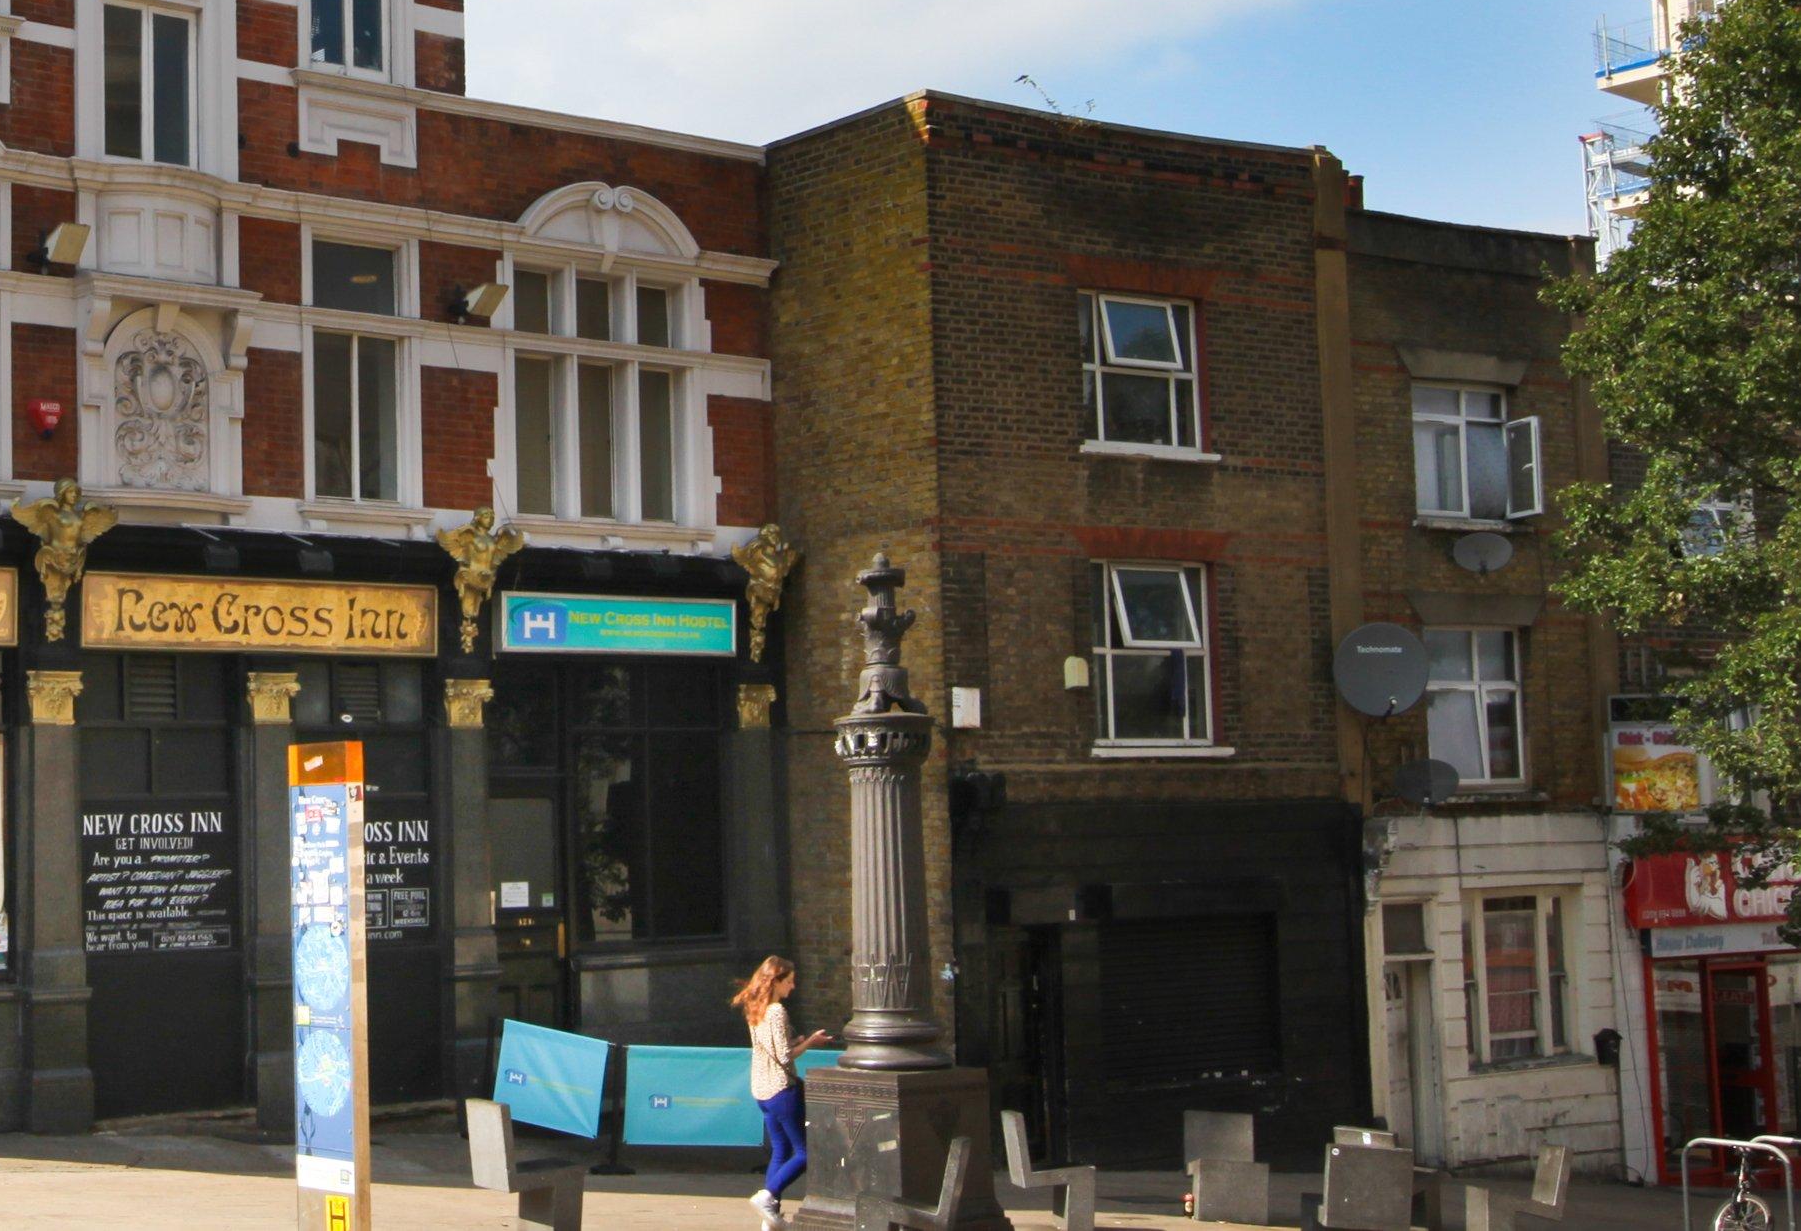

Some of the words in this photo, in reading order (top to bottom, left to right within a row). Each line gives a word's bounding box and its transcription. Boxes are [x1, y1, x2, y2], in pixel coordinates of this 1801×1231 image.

[114, 587, 203, 634] New
[212, 592, 333, 638] Cross
[345, 596, 408, 641] Inn
[605, 611, 649, 626] CROSS
[679, 614, 728, 629] HOSTEL
[83, 814, 123, 835] NEW
[130, 812, 184, 835] CROSS
[190, 812, 223, 833] INN
[364, 821, 393, 843] OSS
[398, 820, 429, 842] INN
[115, 837, 135, 851] GET
[139, 836, 193, 850] INVOLVED!
[93, 852, 110, 866] Are
[113, 856, 134, 868] you
[379, 852, 386, 865] &
[389, 846, 429, 865] Events
[375, 867, 404, 884] week
[99, 886, 124, 896] WANT
[125, 886, 137, 895] TO
[169, 884, 179, 893] A
[169, 894, 209, 905] EVENT?
[86, 910, 106, 921] This
[107, 911, 133, 922] space
[135, 910, 144, 919] is
[86, 931, 99, 943] We
[100, 931, 122, 943] want
[126, 930, 137, 941] to
[85, 942, 105, 953] hear
[108, 940, 130, 951] from
[132, 940, 149, 952] you
